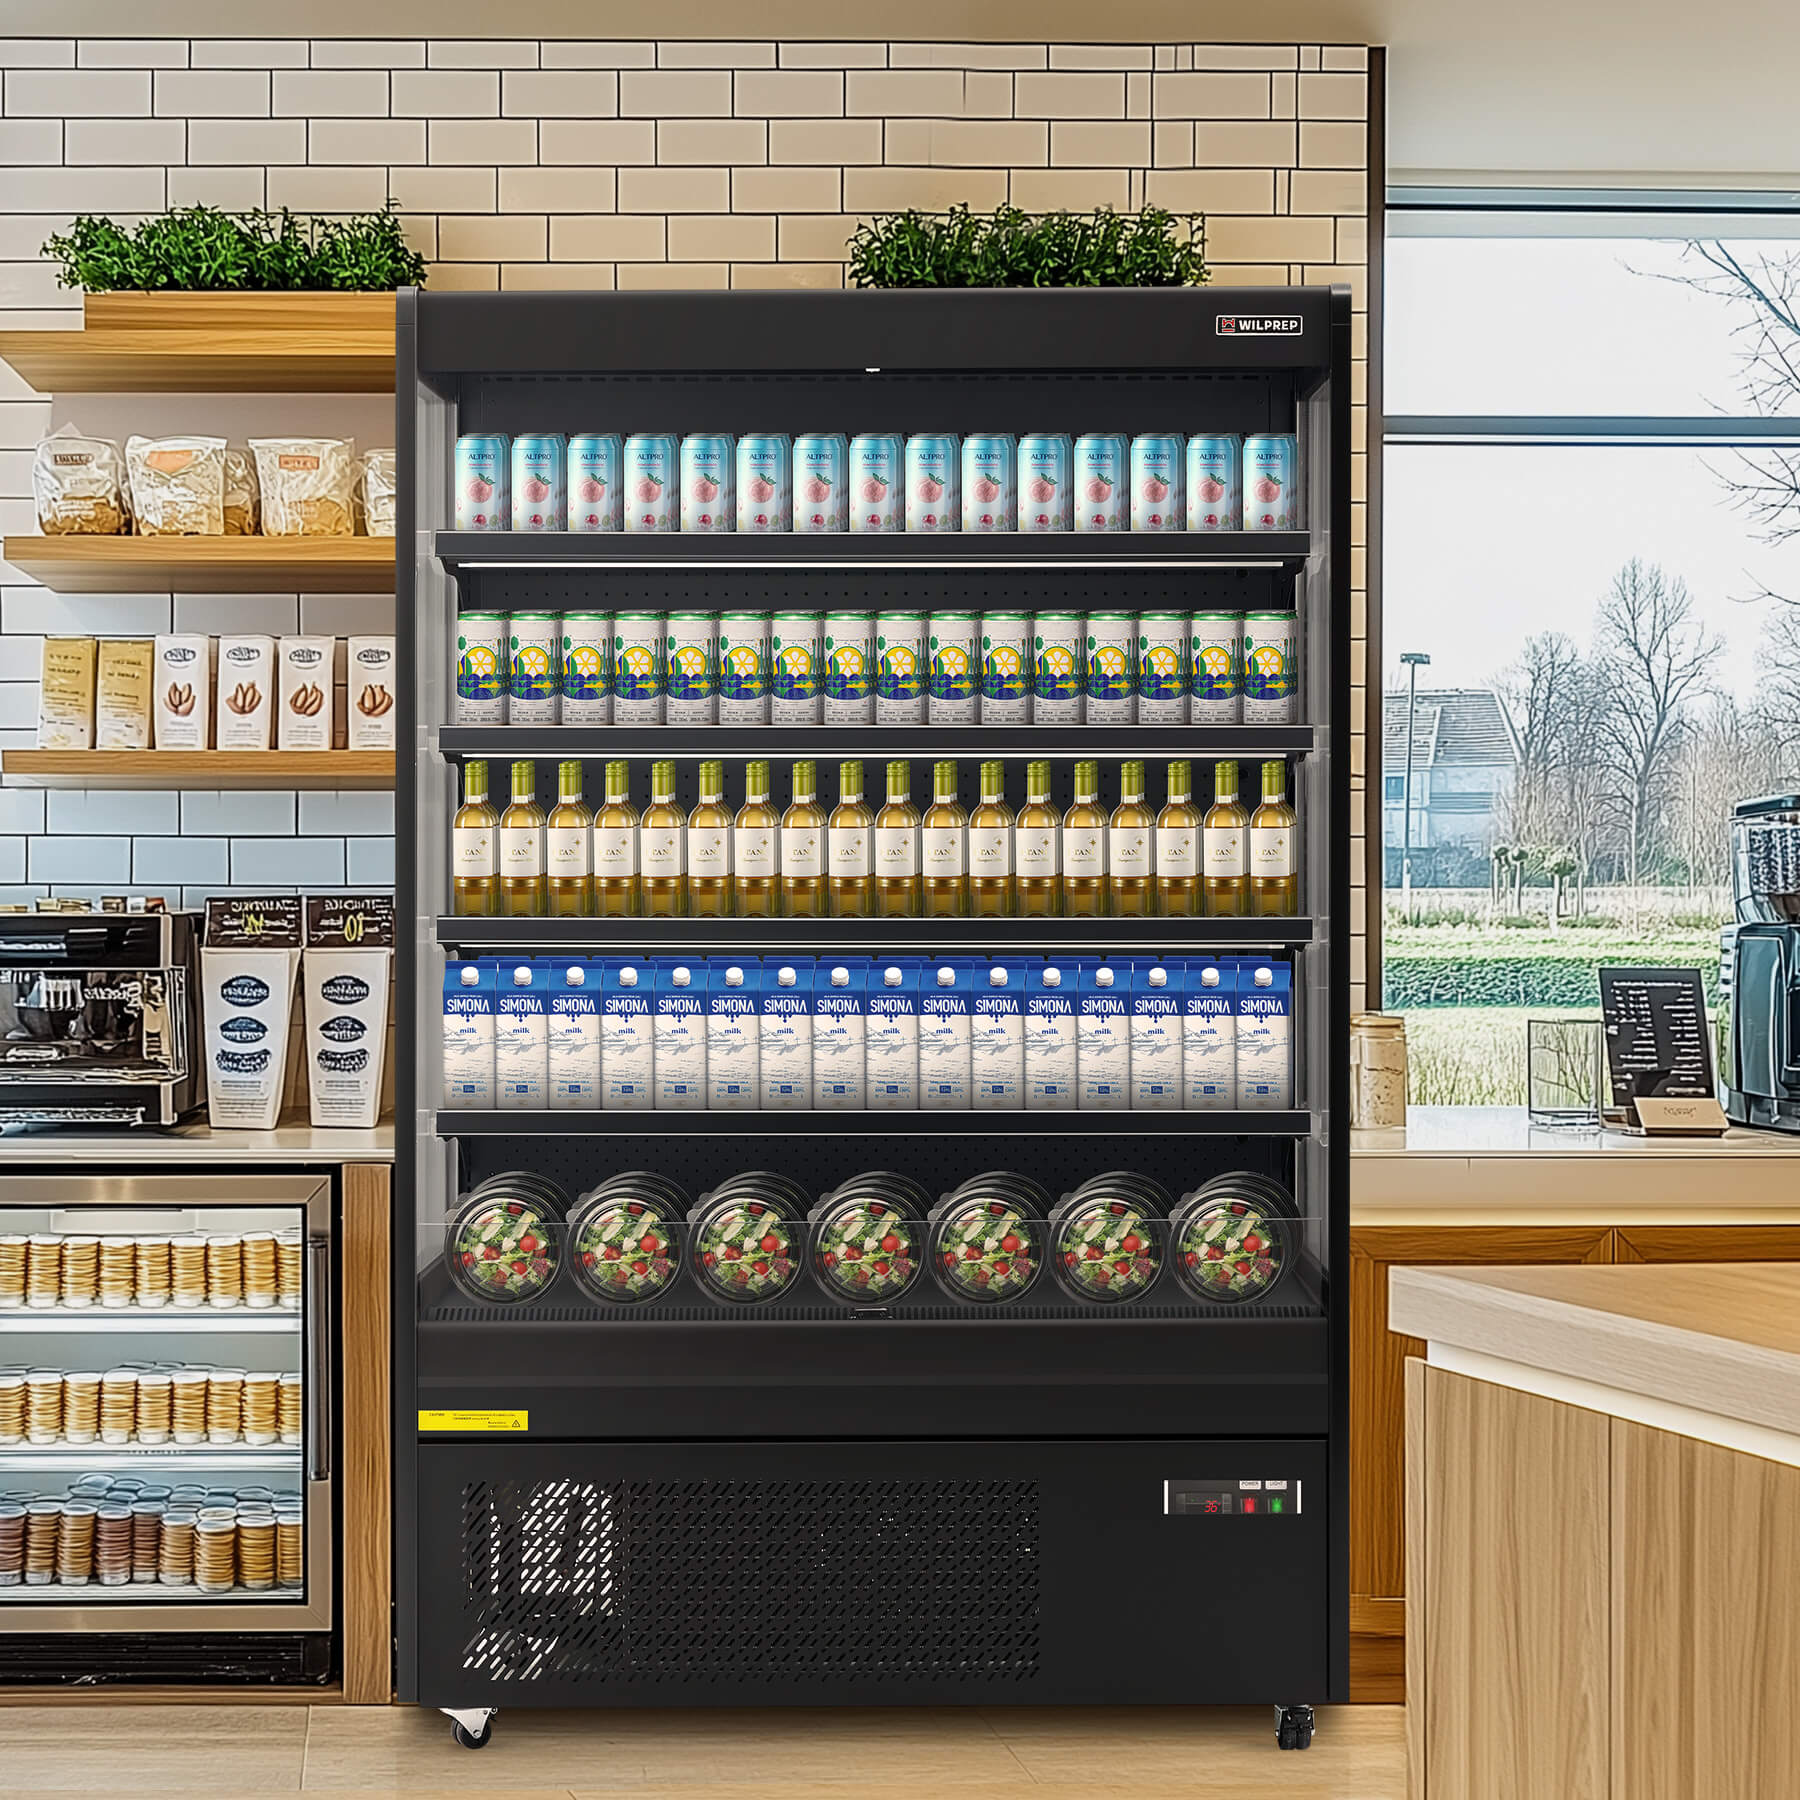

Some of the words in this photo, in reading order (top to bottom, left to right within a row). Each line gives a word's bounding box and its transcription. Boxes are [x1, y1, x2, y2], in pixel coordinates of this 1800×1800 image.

[1238, 319, 1298, 331] WILPREP
[446, 998, 490, 1013] SIMONA
[500, 998, 543, 1013] SIMONA
[552, 998, 596, 1013] SIMONA
[606, 999, 649, 1014] SIMONA
[658, 999, 702, 1014] SIMONA
[712, 999, 755, 1014] SIMONA
[764, 998, 807, 1013] SIMONA
[816, 998, 860, 1013] SIMONA
[870, 998, 913, 1013] SIMONA
[922, 998, 966, 1013] SIMONA
[976, 998, 1019, 1013] SIMONA
[1028, 999, 1072, 1014] SIMONA
[1082, 999, 1125, 1014] SIMONA
[1134, 999, 1178, 1014] SIMONA
[1186, 999, 1230, 1014] SIMONA
[1240, 999, 1284, 1014] SIMONA
